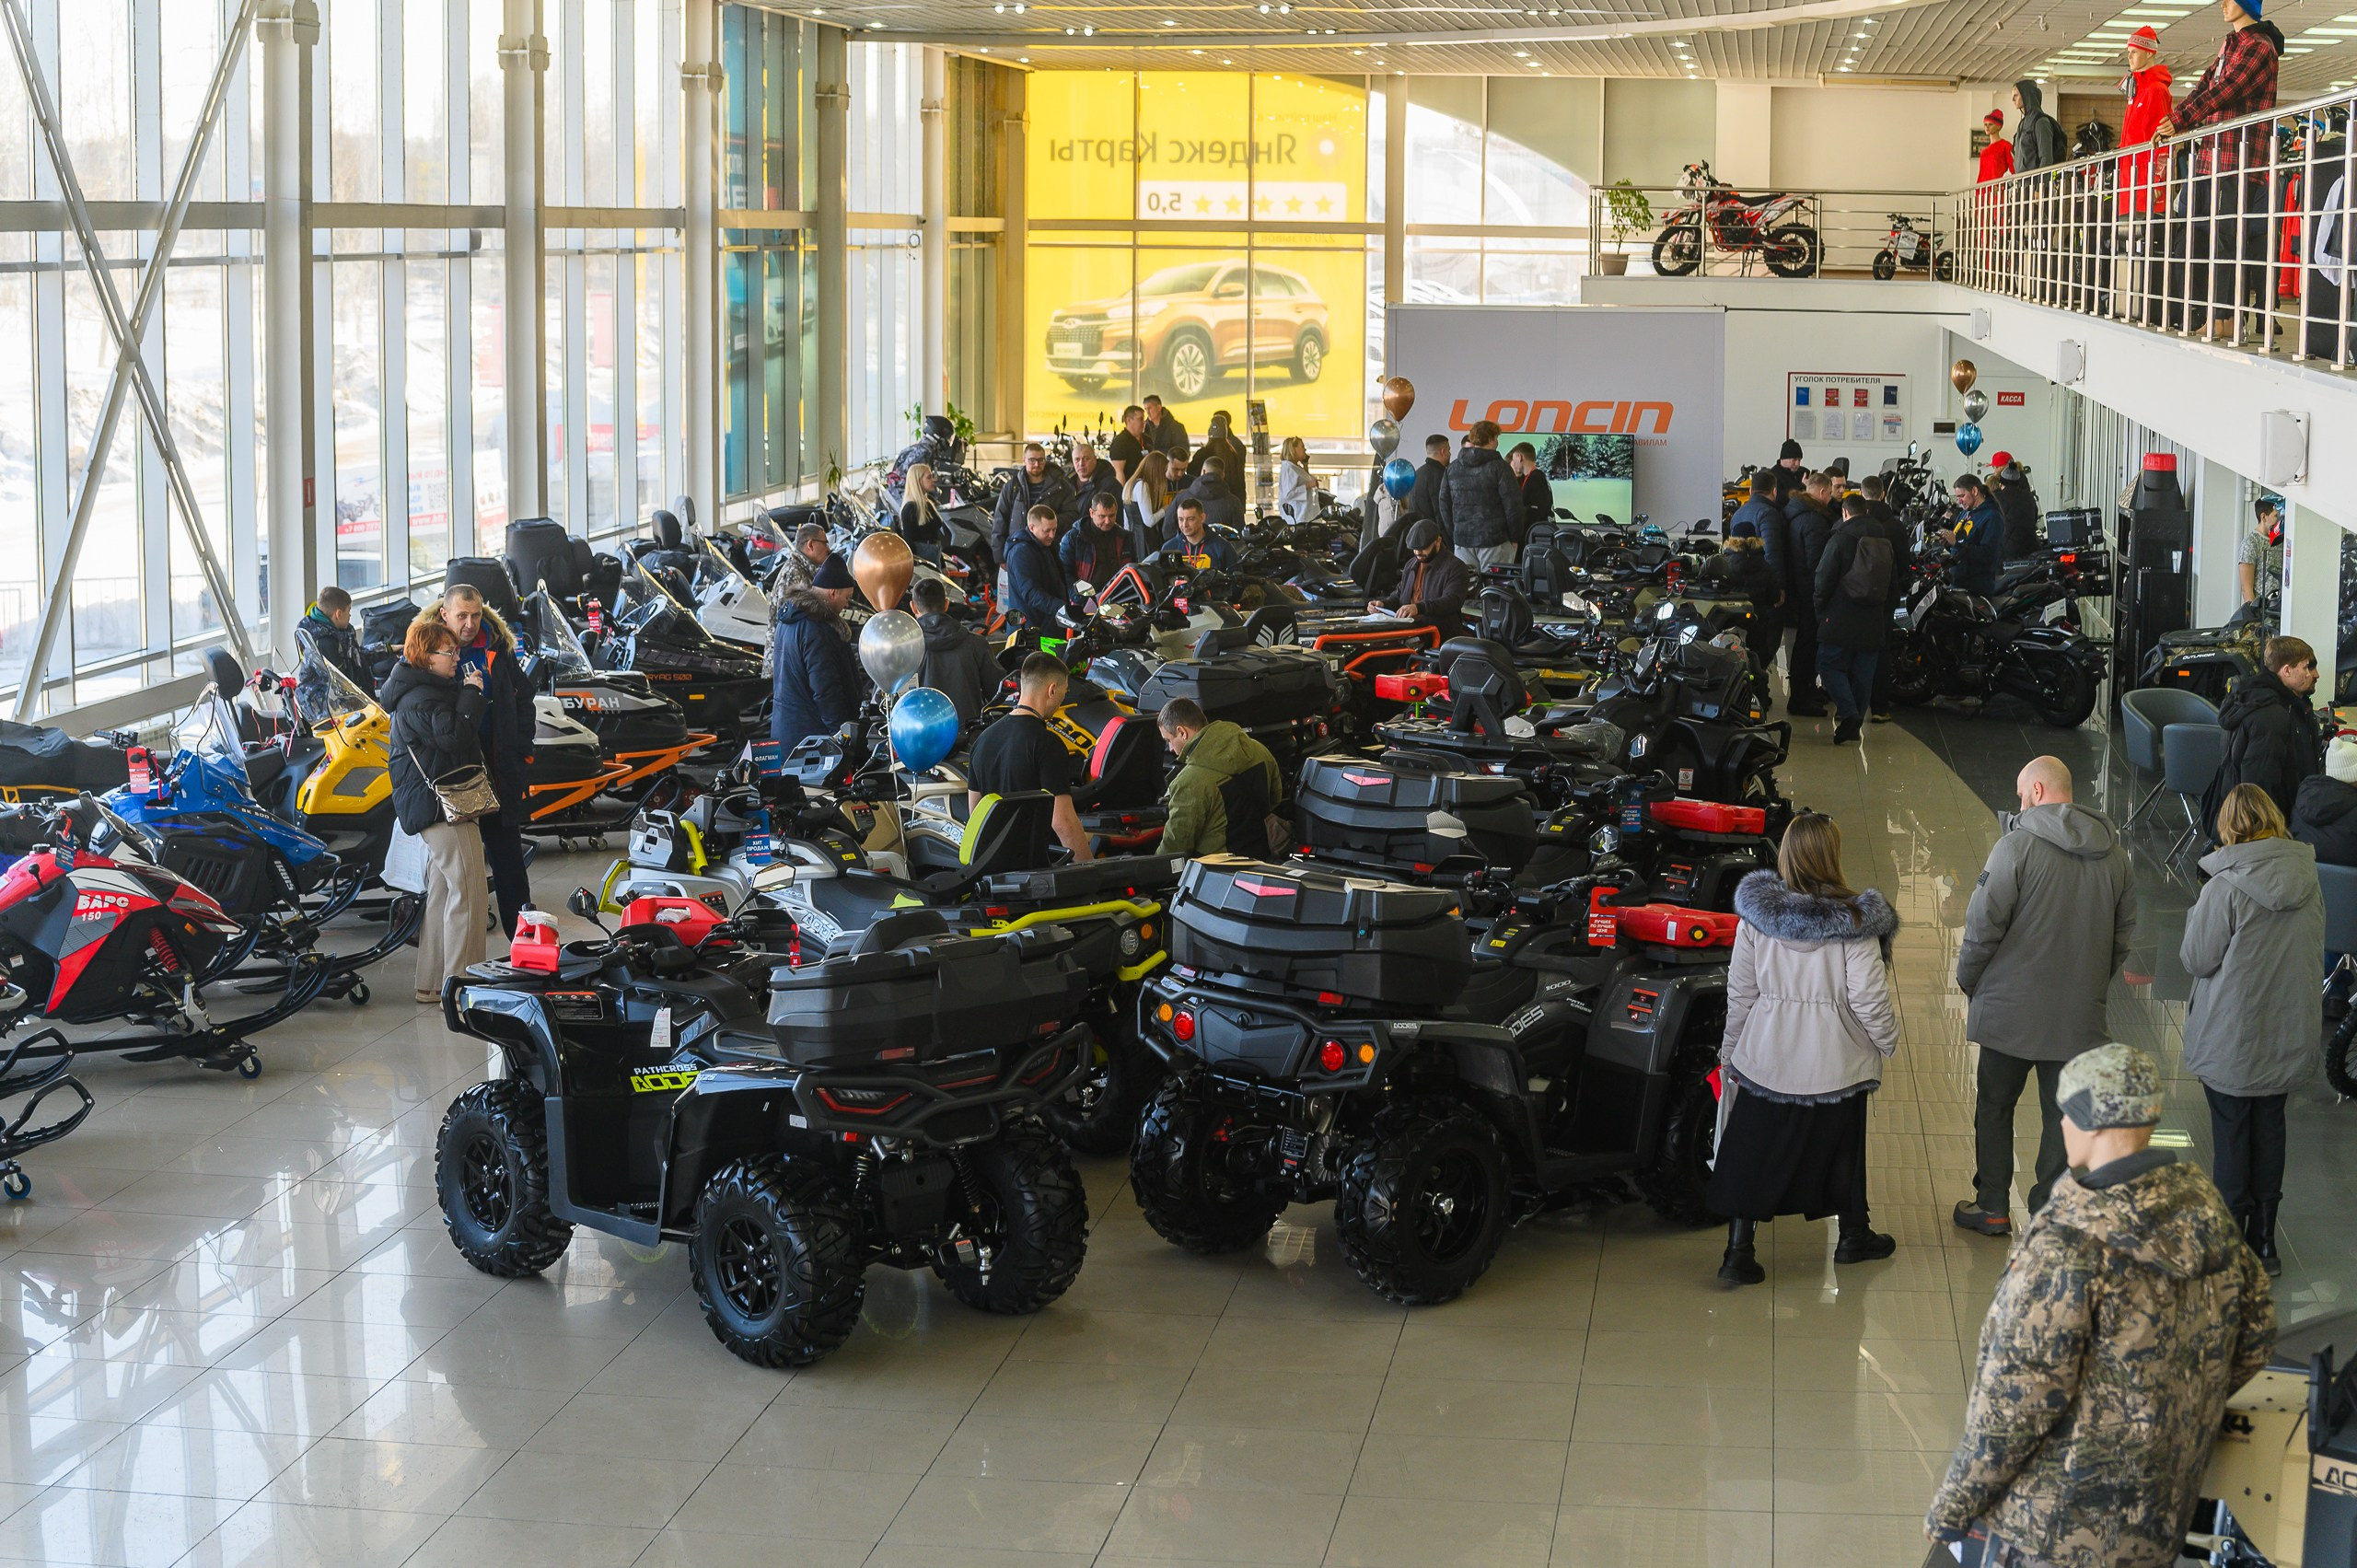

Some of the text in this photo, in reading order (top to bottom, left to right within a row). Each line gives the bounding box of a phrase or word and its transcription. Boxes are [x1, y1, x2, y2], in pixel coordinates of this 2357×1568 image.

[2001, 395, 2022, 404] КАССА
[1448, 400, 1675, 434] LONCIN
[2182, 652, 2216, 660] OUTLANDER
[645, 673, 692, 681] RYAG 500
[560, 696, 621, 709] БУРАН
[76, 894, 130, 911] БАРС
[81, 911, 102, 922] 150
[1546, 980, 1572, 991] 1000
[633, 1063, 698, 1075] PATHCROSS
